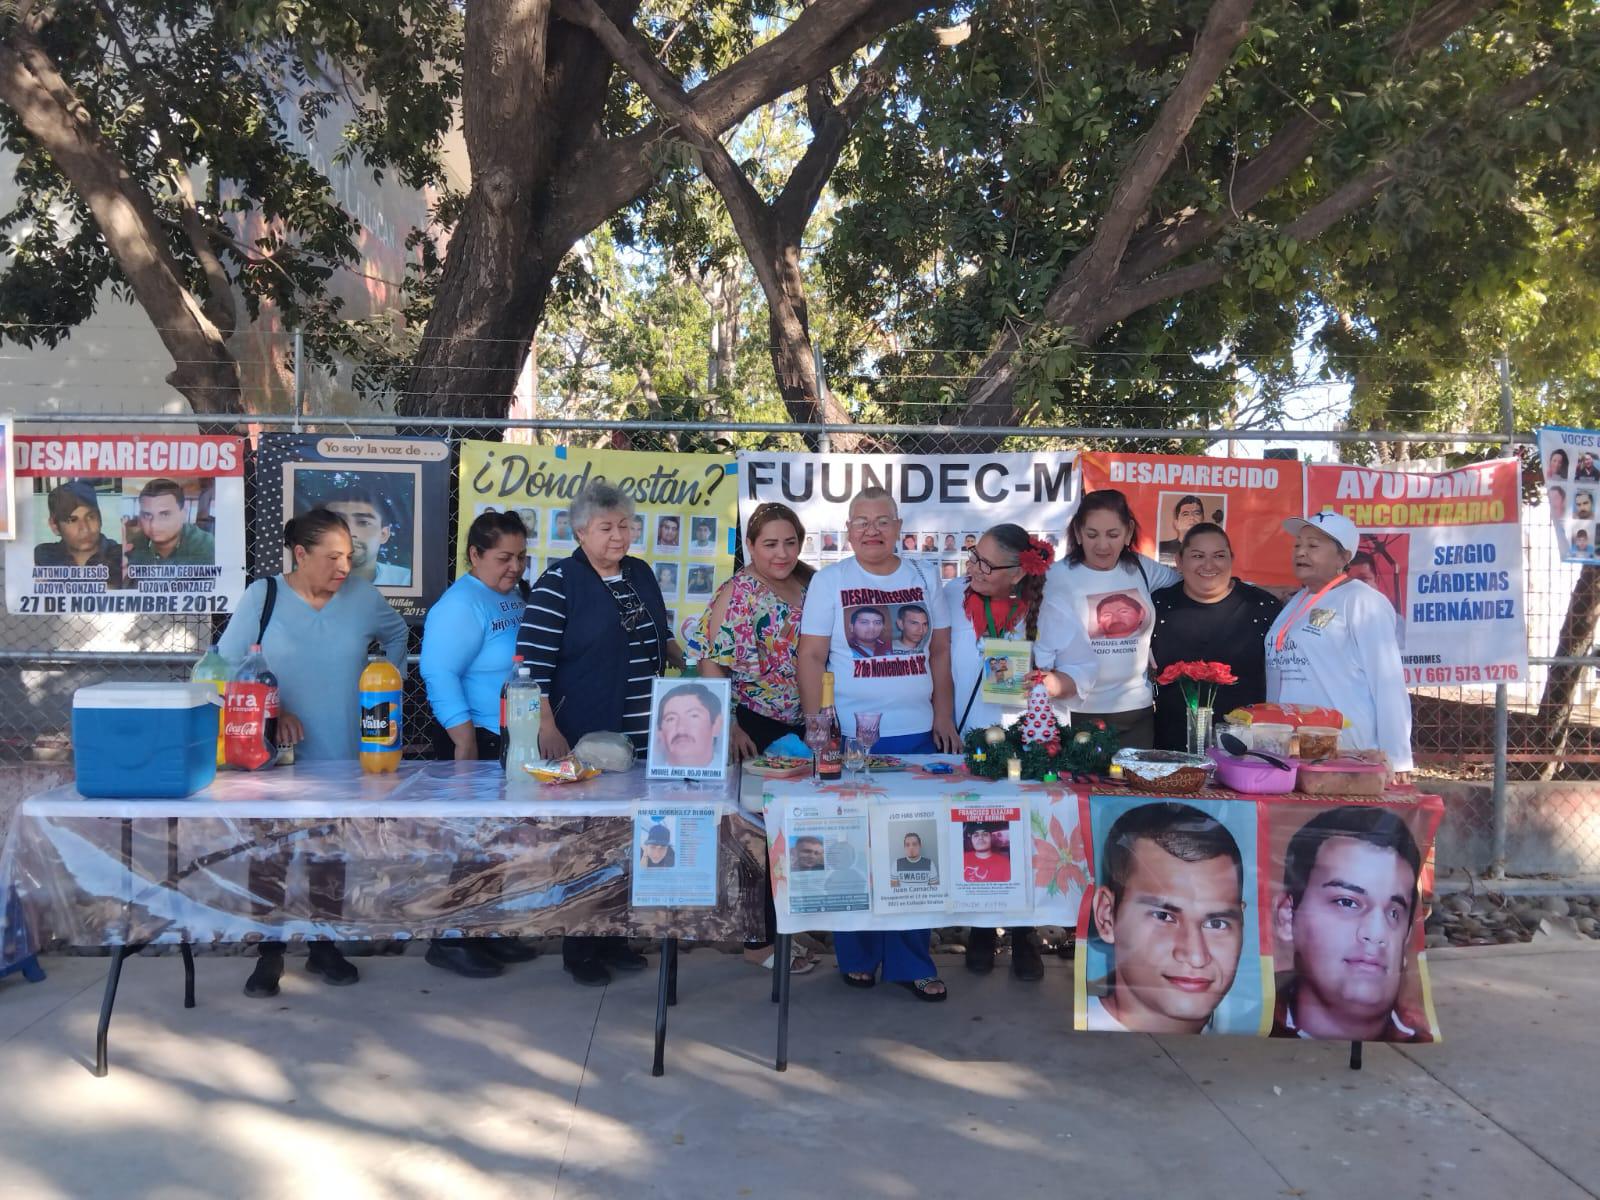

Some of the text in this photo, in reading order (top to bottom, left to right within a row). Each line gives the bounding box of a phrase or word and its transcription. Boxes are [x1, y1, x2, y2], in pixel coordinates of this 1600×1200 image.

[325, 442, 340, 452] Yo
[343, 445, 364, 455] soy
[368, 443, 378, 453] la
[405, 445, 421, 455] de
[1561, 433, 1593, 447] VOCES
[15, 441, 236, 471] DESAPARECIDOS
[747, 461, 1073, 503] FUUNDEC-M
[1110, 461, 1279, 489] DESAPARECIDO
[1336, 467, 1496, 499] AYUDAME
[618, 463, 725, 506] están?
[1343, 500, 1505, 526] ENCONTRARLO
[1433, 543, 1496, 566] SERGIO
[32, 564, 109, 579] ANTONIO DE JESÚS
[129, 566, 222, 578] CHRISTIAN GEOVANNY
[33, 582, 106, 594] LOZOYA GONZALEZ
[139, 581, 212, 593] LOZOYA GONZALEZ
[1417, 570, 1509, 594] CÁRDENAS
[20, 595, 229, 613] 27 DE NOVIEMBRE 2012
[403, 607, 426, 616] 2015
[1413, 597, 1514, 622] HERNÁNDEZ
[1401, 655, 1441, 664] INFORMES
[1414, 667, 1422, 682] Y
[1426, 667, 1452, 683] 667
[1456, 665, 1481, 681] 573
[1484, 664, 1519, 682] 1276
[363, 720, 386, 728] Valle
